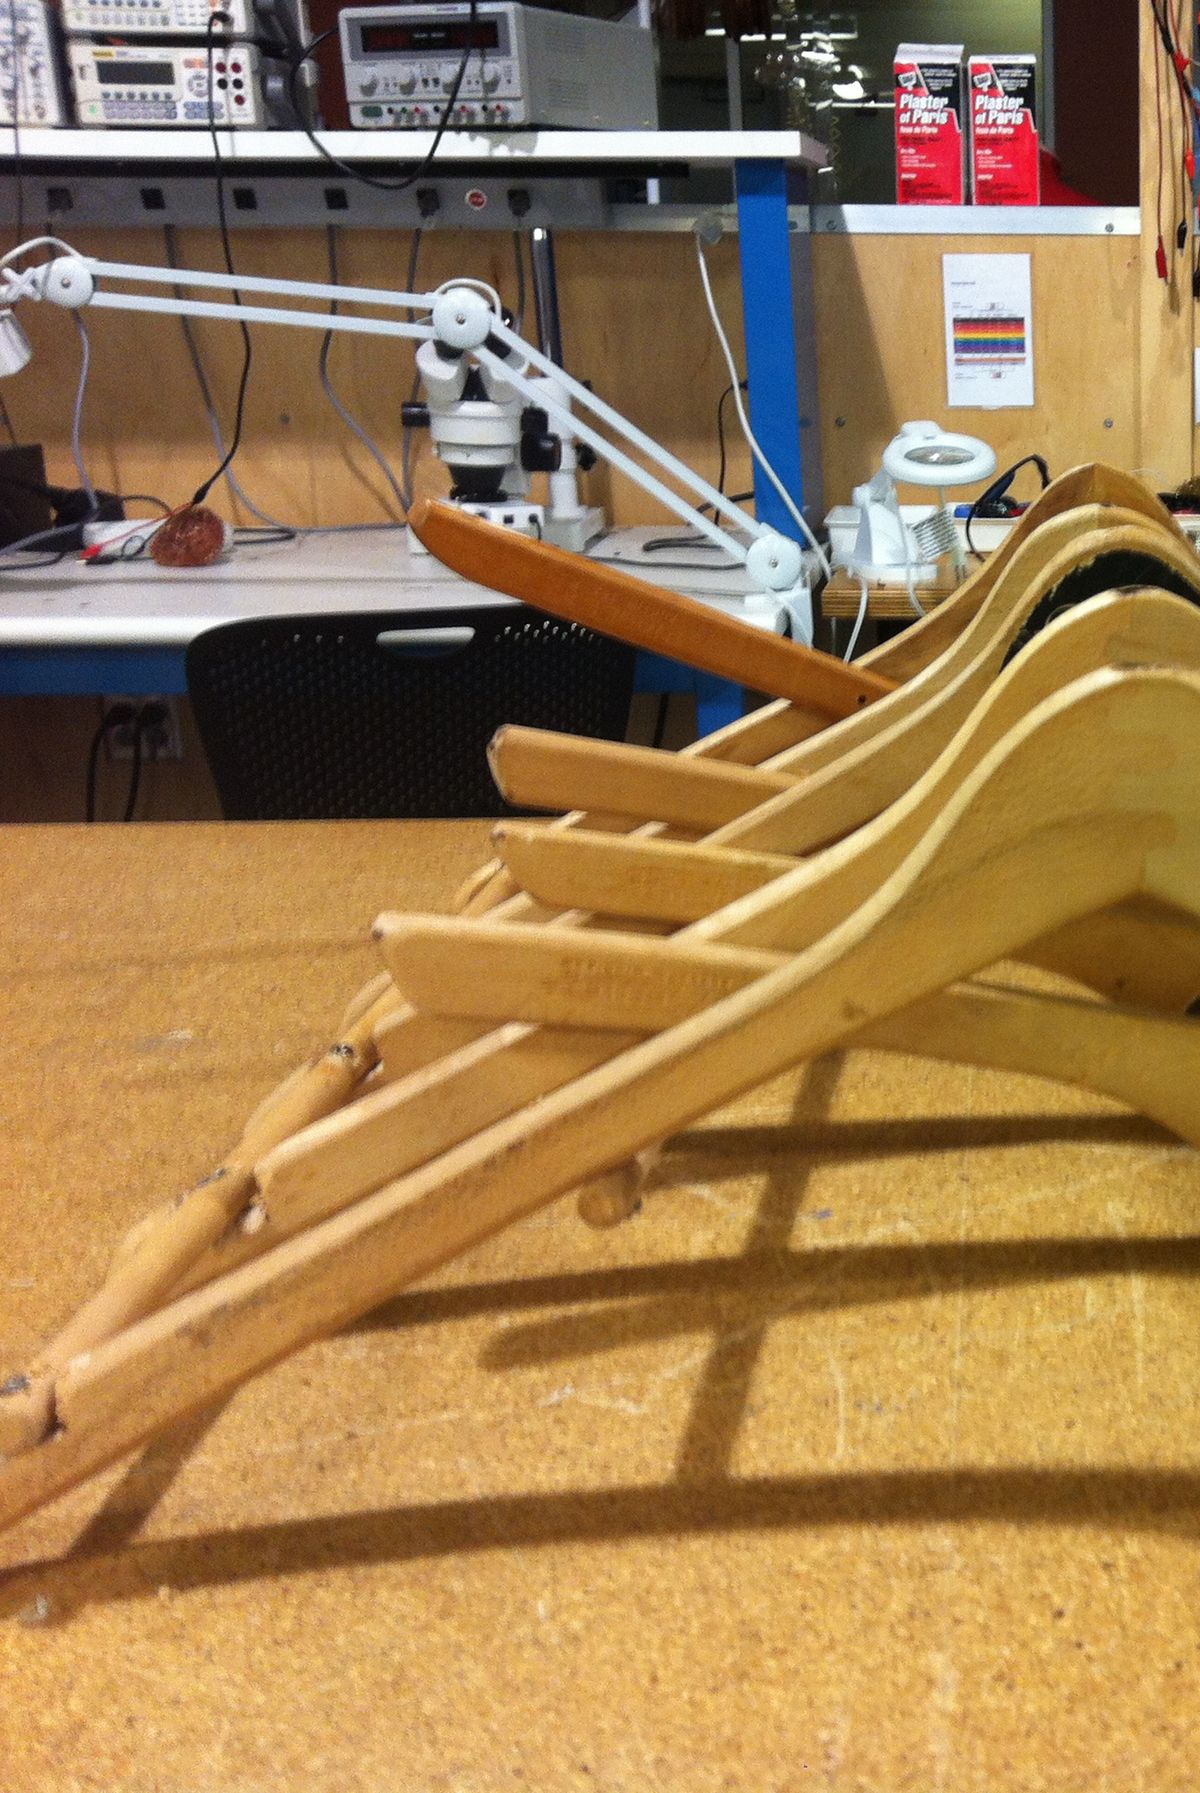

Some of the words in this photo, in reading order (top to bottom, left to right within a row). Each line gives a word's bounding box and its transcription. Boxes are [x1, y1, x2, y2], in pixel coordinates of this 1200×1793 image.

[900, 94, 948, 109] Plaster
[975, 95, 1024, 110] Plaster
[900, 111, 911, 124] of
[912, 109, 948, 124] Paris
[975, 112, 986, 125] of
[988, 109, 1024, 125] Paris
